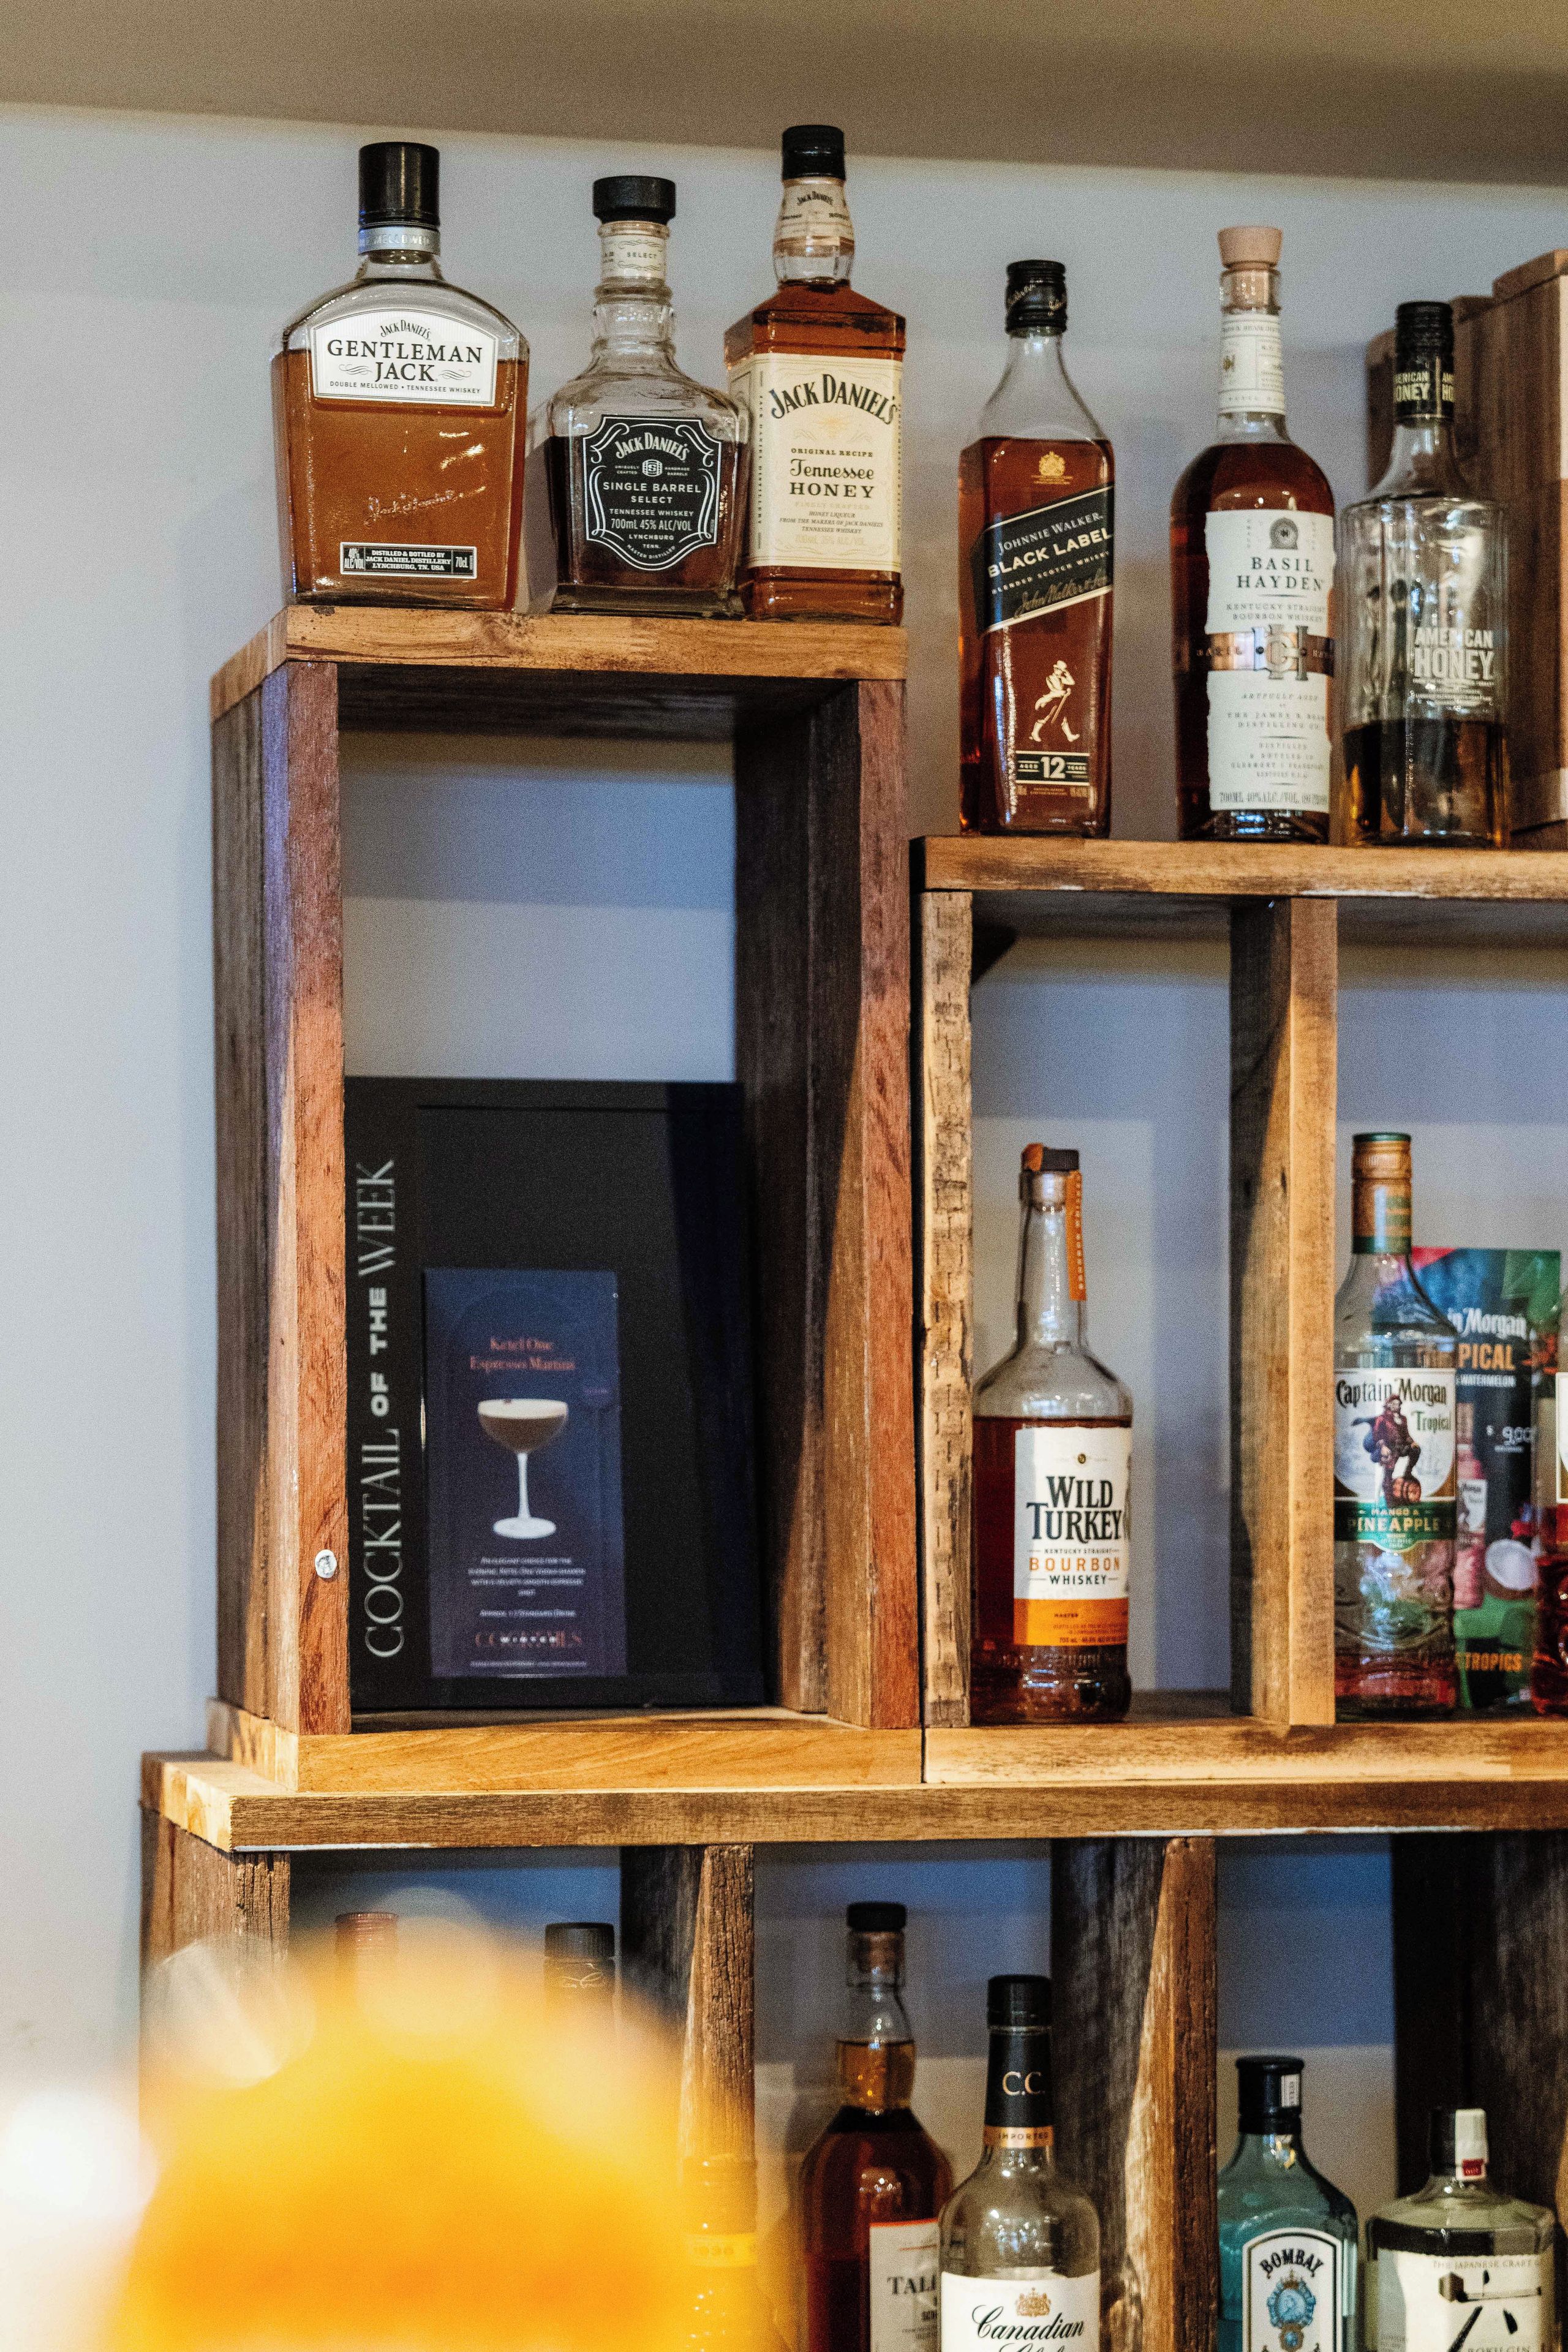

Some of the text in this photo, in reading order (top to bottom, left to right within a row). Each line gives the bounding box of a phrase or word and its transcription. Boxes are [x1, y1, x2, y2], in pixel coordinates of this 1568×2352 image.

[380, 319, 431, 340] JACK DANIEL'S
[327, 339, 483, 364] GENTLEMAN
[374, 361, 435, 383] JACK
[407, 384, 447, 393] TENNESSEE
[769, 374, 899, 425] JACK DANIEL'S
[614, 432, 690, 461] JACK DANIEL'S
[789, 458, 875, 480] Tennessee
[603, 481, 702, 493] SINGLE BARREL
[789, 481, 875, 499] HONEY
[631, 496, 673, 504] SELECT
[609, 508, 656, 516] TENNESSEE
[611, 518, 693, 532] 700mL 45% ALC/VOL
[627, 544, 647, 559] MASTER
[987, 546, 1050, 579] BLACK
[1052, 526, 1114, 557] LABEL
[998, 528, 1050, 556] JOHNNIE
[1251, 556, 1314, 573] BASIL
[991, 576, 1033, 595] BLENDED
[1038, 564, 1072, 579] SCOTCH
[1236, 575, 1324, 592] HAYDEN
[1414, 647, 1494, 680] HONEY
[1041, 756, 1066, 779] 12
[1461, 1306, 1528, 1340] Morgan
[1457, 1343, 1516, 1371] PICAL
[1335, 1377, 1447, 1409] Captain Morgan
[356, 1158, 405, 1659] COCKTAIL OF THE WEEK
[1411, 1409, 1452, 1433] Tropical
[1045, 1475, 1114, 1509] WILD
[1025, 1501, 1124, 1545] TURKEY
[1029, 1556, 1121, 1572] BOURBON
[1049, 1574, 1107, 1585] WHISKEY
[998, 2131, 1049, 2140] IMPORTED
[1258, 2248, 1324, 2280] BOMBAY
[971, 2304, 1085, 2340] Canadian
